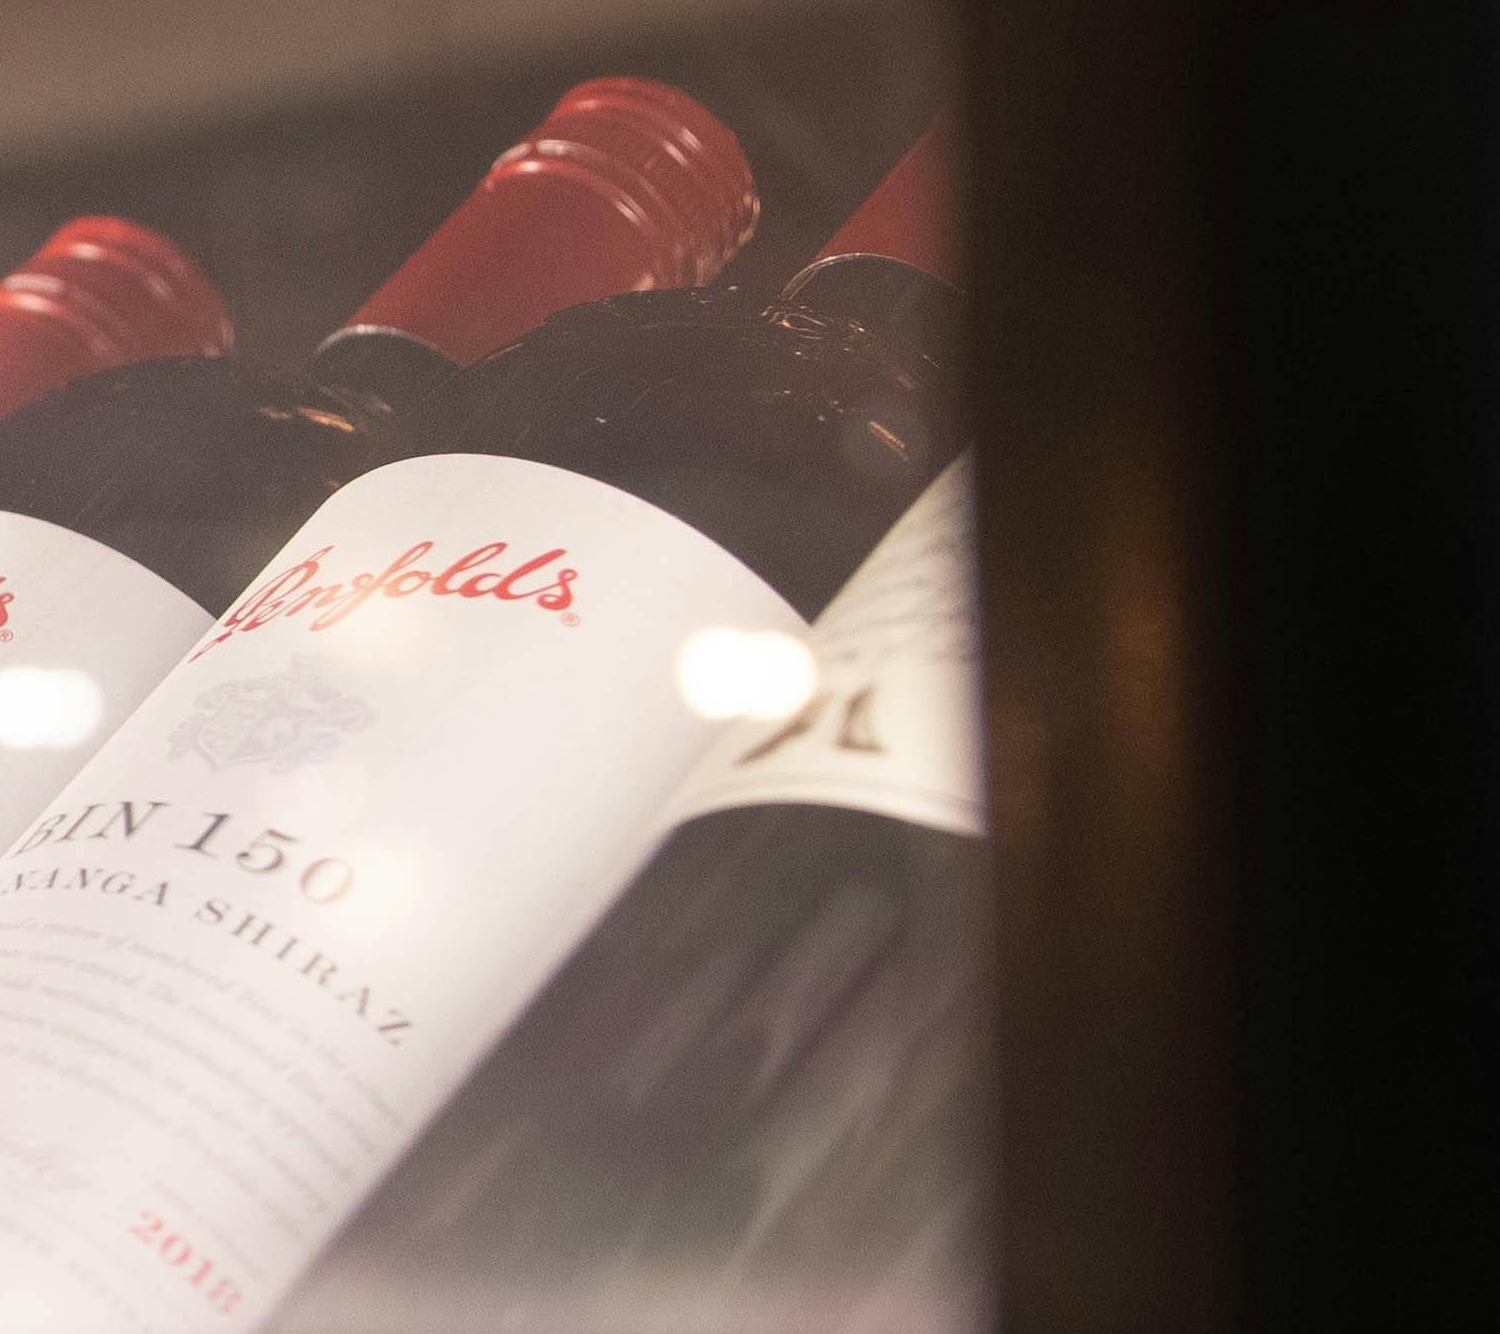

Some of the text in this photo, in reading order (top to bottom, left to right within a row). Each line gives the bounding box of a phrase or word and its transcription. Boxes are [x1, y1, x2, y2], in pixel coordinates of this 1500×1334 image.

[172, 811, 356, 907] 150
[193, 896, 416, 1047] SHIRAZ
[127, 1209, 245, 1315] 2018
